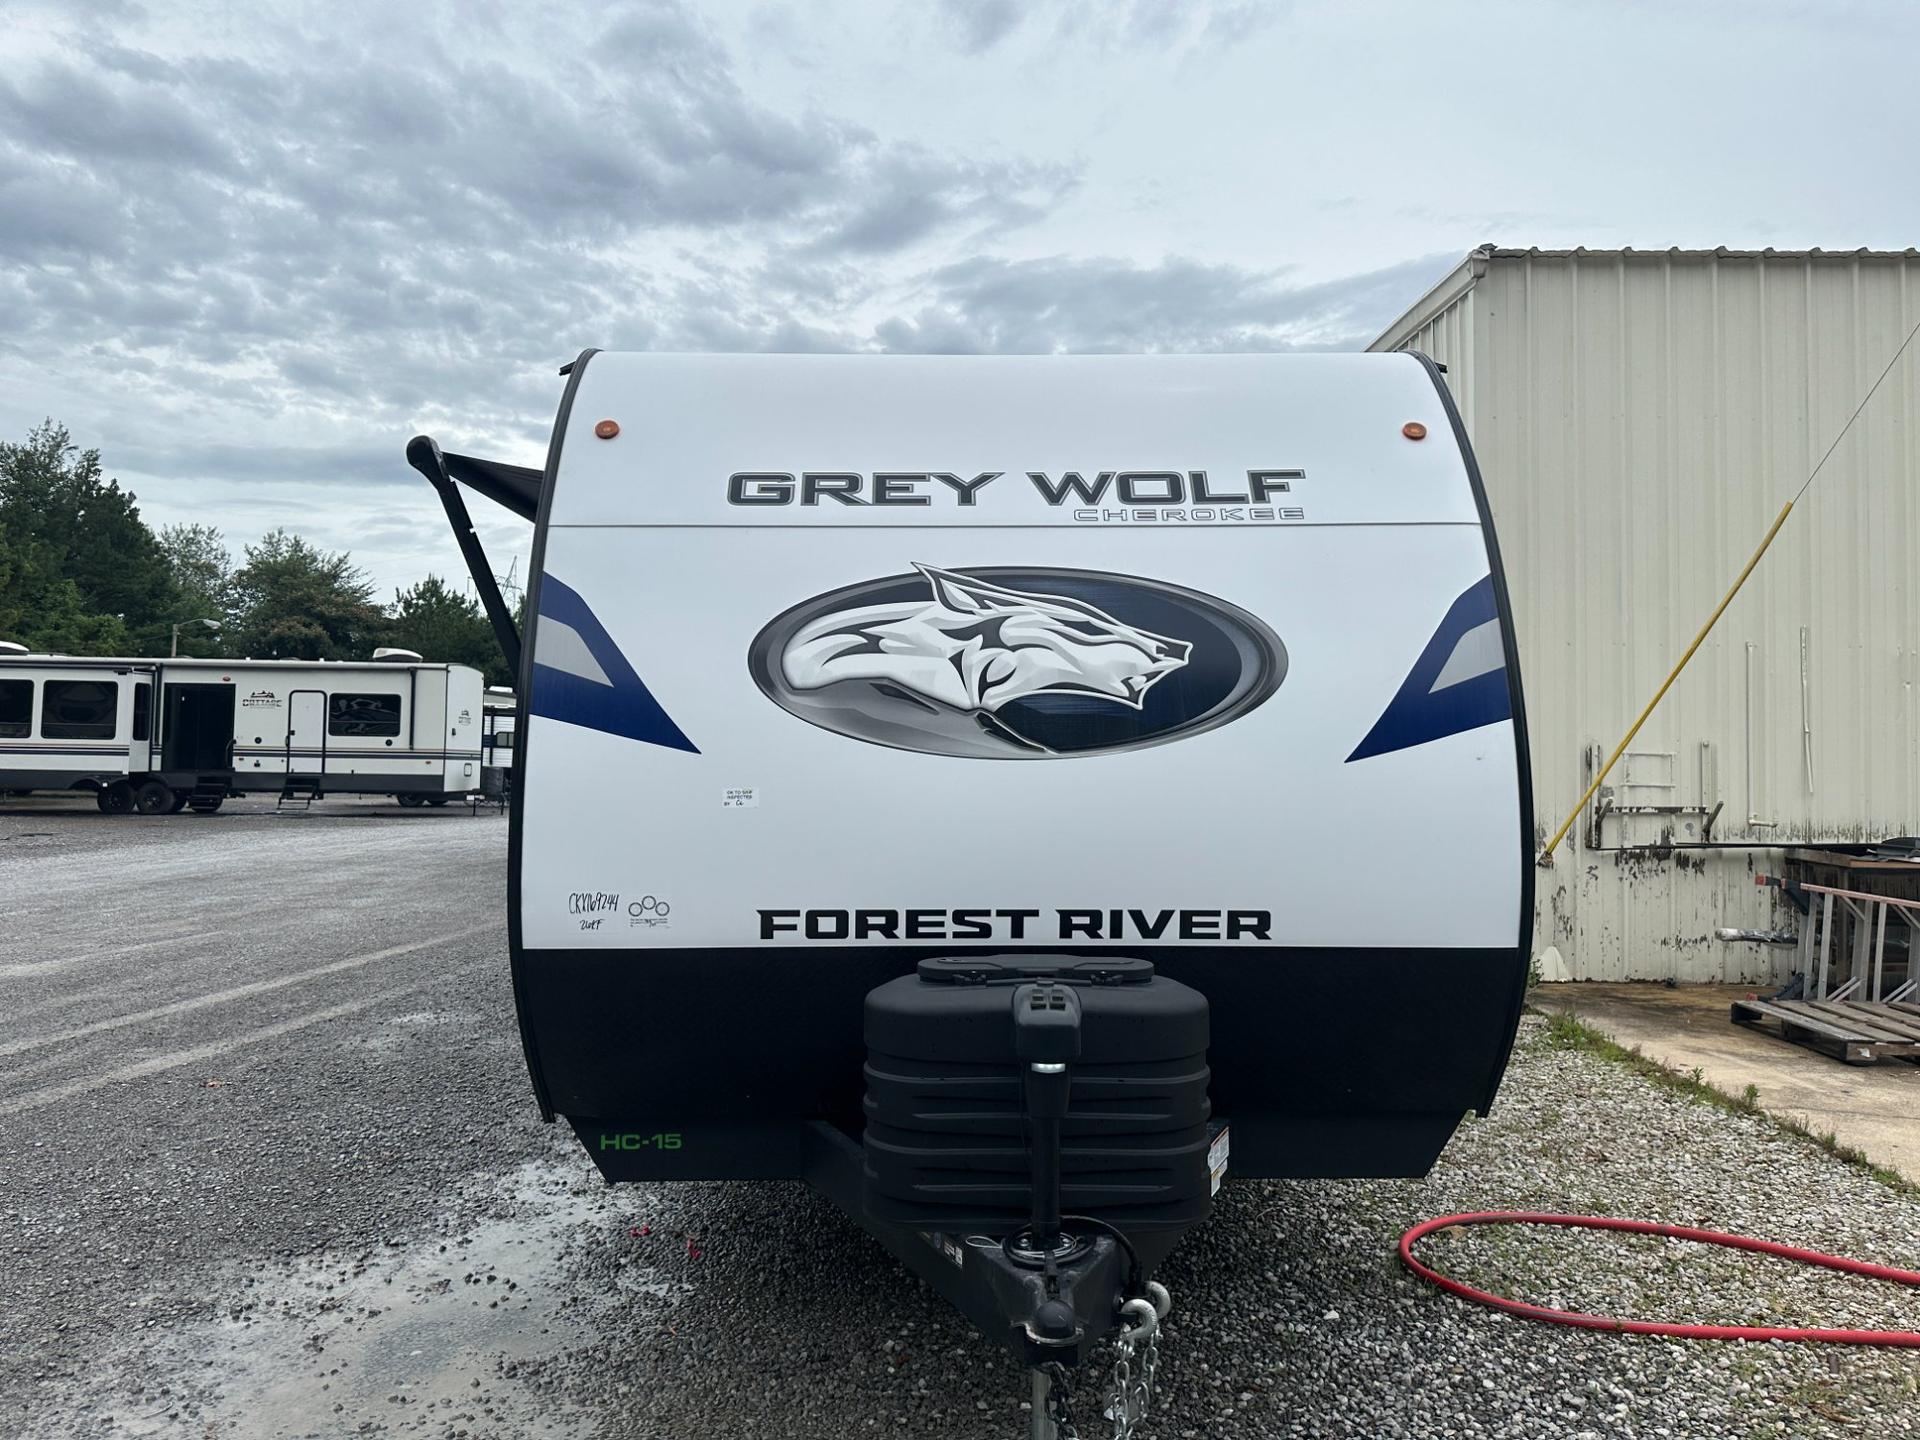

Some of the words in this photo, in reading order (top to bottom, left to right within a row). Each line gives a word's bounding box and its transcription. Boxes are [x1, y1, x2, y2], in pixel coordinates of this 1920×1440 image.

[727, 471, 1005, 506] GREY
[1025, 469, 1306, 506] WOLF
[1073, 507, 1305, 522] CHEROKEE
[756, 908, 1040, 940] FOREST
[1055, 908, 1273, 940] RIVER
[600, 1133, 682, 1151] HC-15
